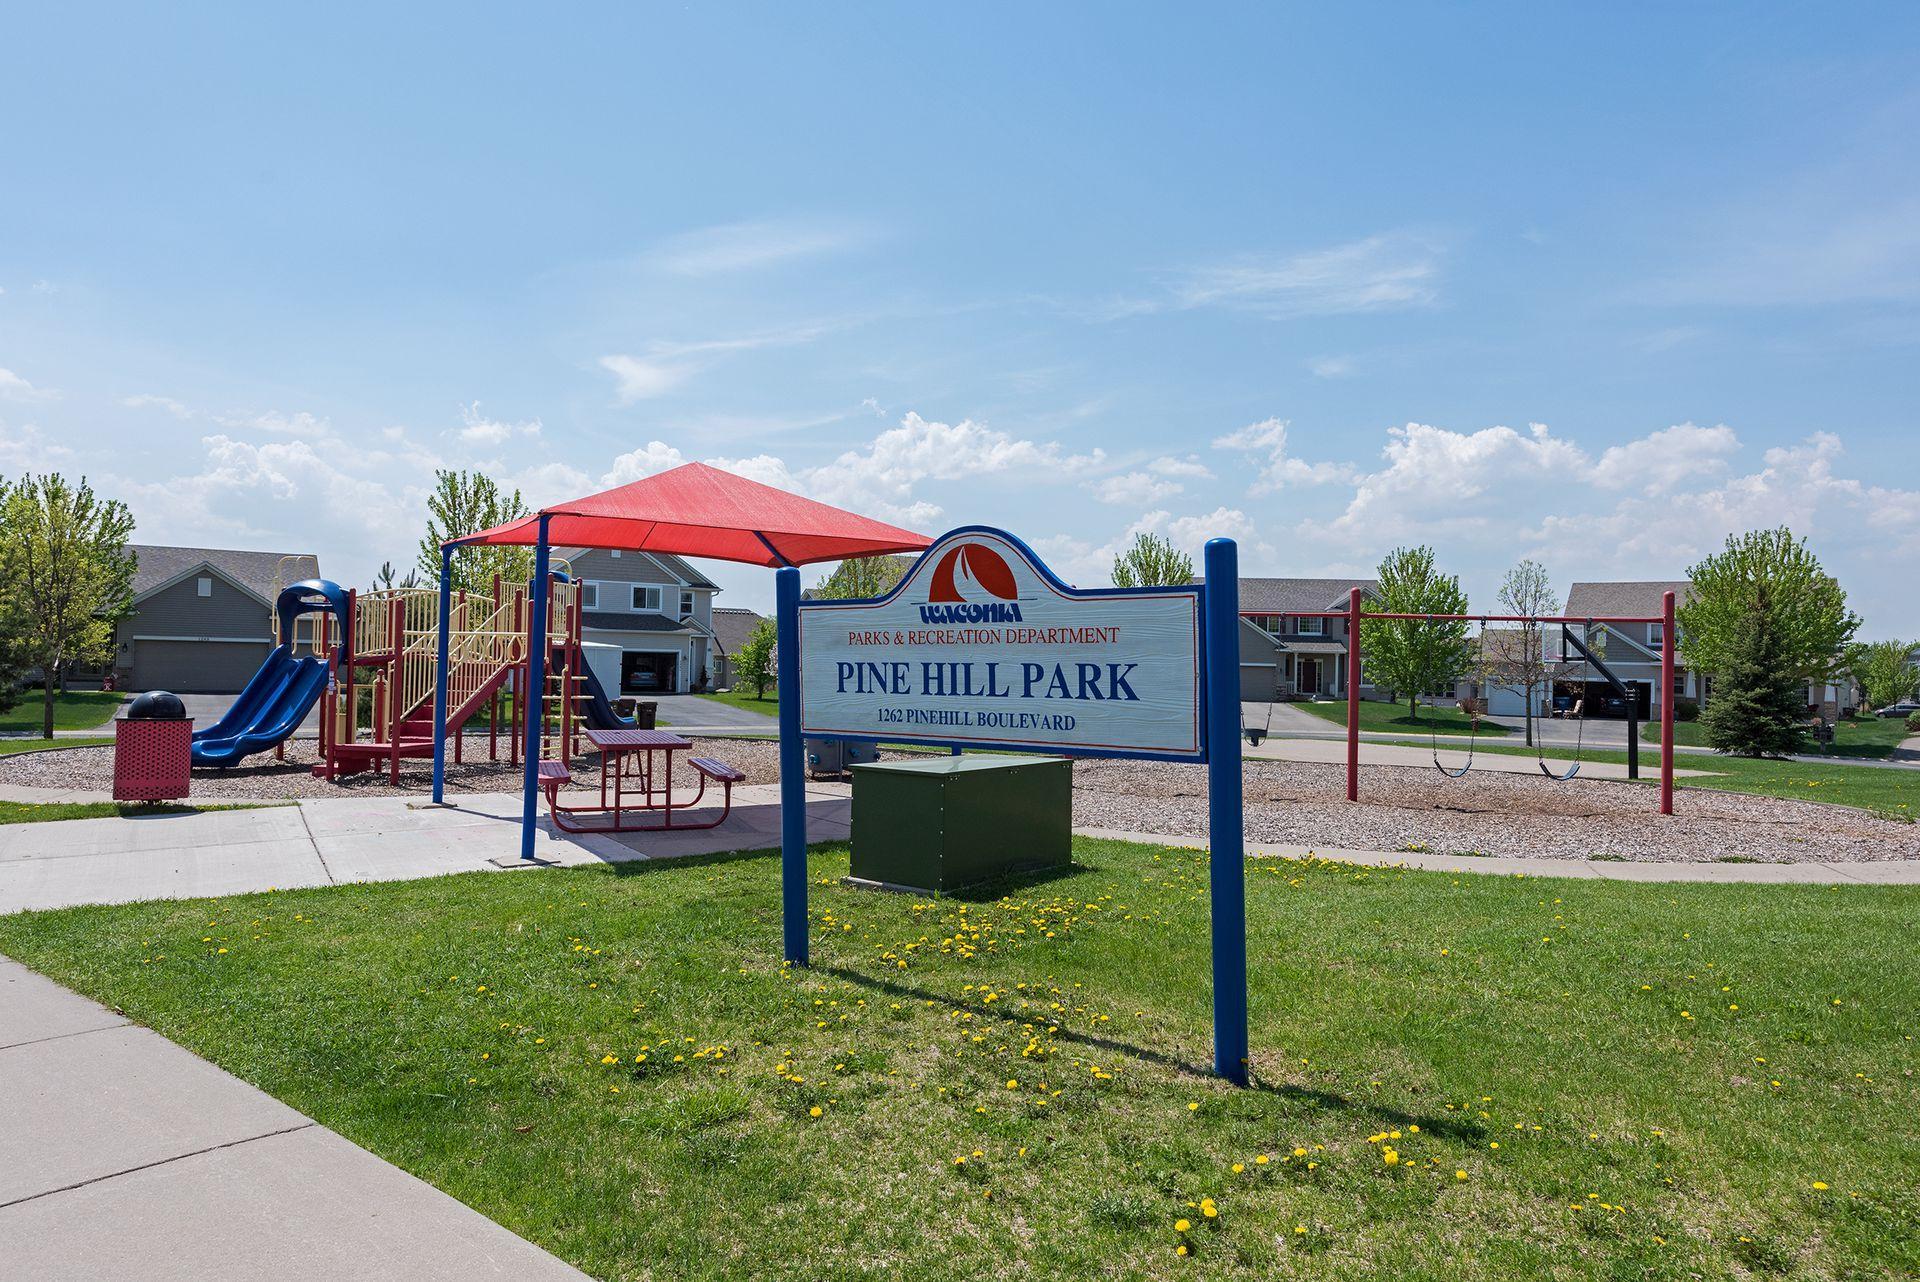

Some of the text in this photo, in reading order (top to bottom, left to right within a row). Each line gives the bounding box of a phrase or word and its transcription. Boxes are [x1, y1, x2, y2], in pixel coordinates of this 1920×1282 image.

[848, 626, 1120, 646] PARKS & RECREATION DEPARTMENT
[836, 661, 1140, 701] PINE HILL PARK
[877, 708, 1076, 731] 1262 PINEHILL BOULEVARD
